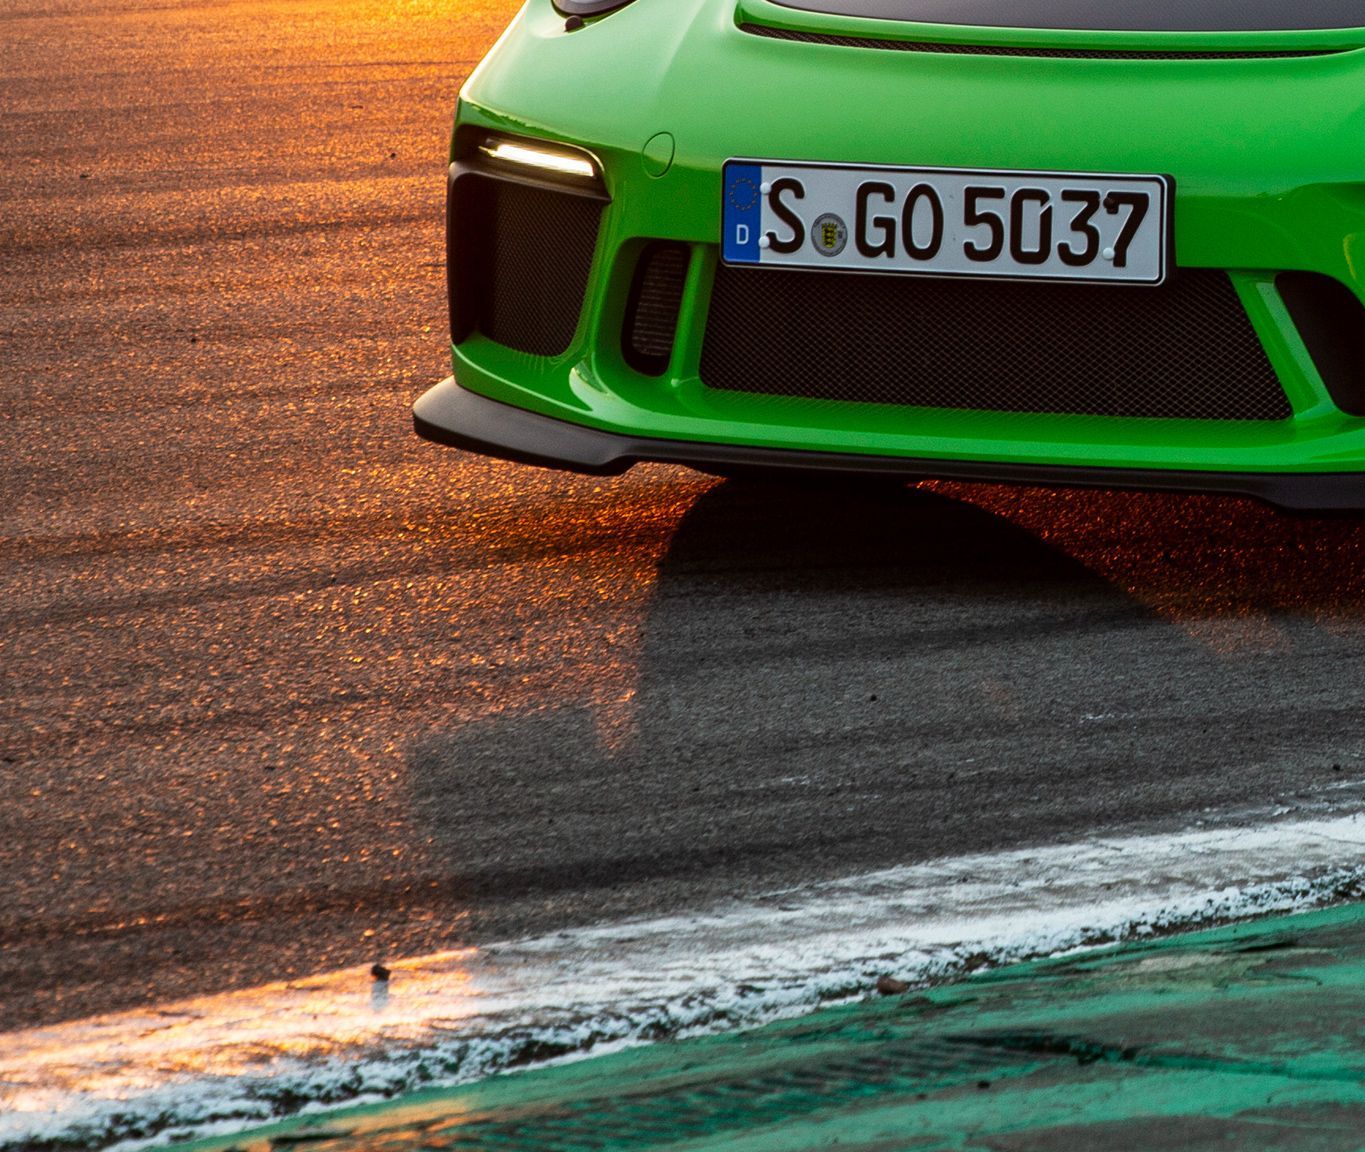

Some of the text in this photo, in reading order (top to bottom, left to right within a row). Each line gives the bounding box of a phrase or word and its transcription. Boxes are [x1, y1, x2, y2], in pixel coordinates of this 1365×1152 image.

[736, 224, 749, 245] D
[764, 177, 806, 254] S
[855, 181, 944, 261] GO
[963, 185, 1150, 267] 5037
